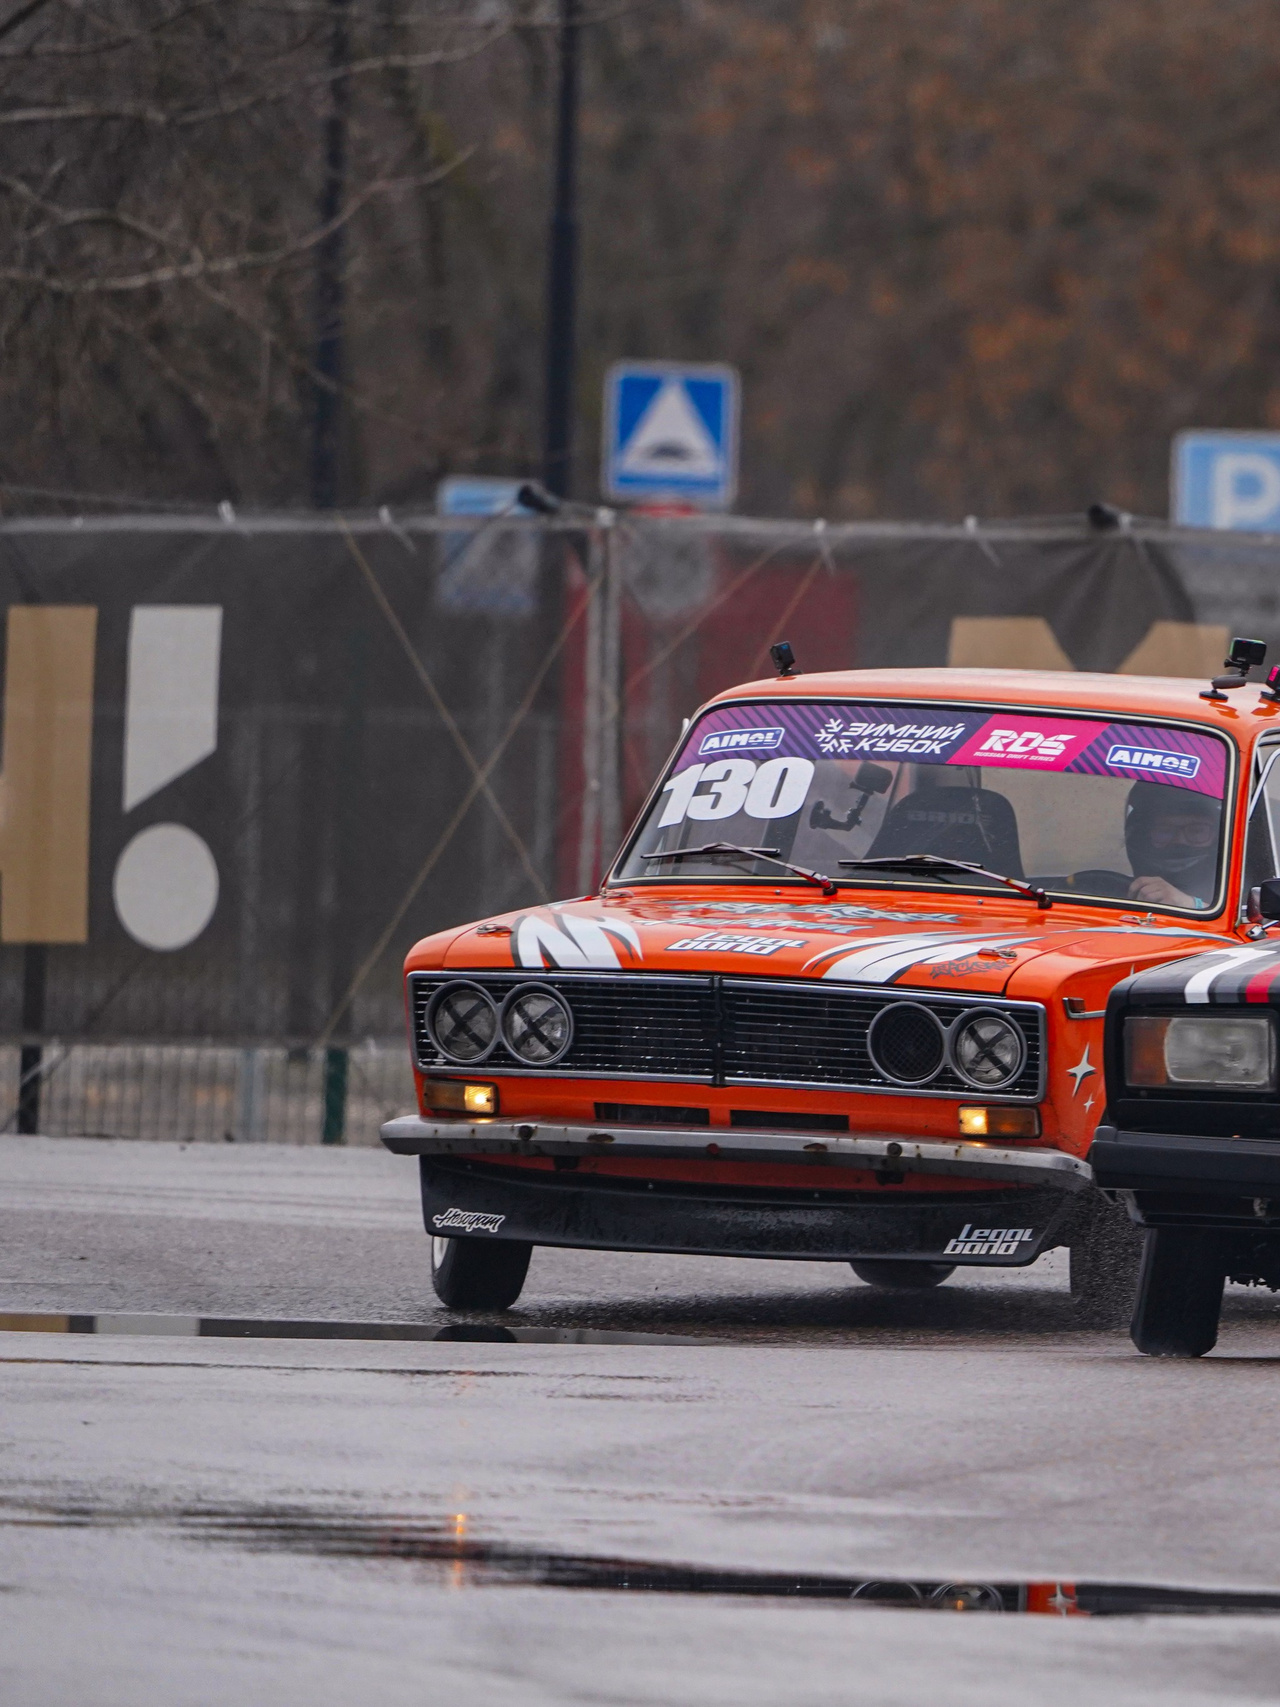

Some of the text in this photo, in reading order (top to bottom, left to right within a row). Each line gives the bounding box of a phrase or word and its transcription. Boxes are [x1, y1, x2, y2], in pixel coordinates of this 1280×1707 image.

[842, 723, 966, 740] ЗИМНИЙ
[703, 732, 777, 751] AIMOL
[854, 738, 952, 754] КУБОК
[979, 729, 1077, 756] RDS
[973, 751, 1007, 759] RUSSIAN
[1111, 749, 1194, 774] AIMOL
[657, 756, 815, 829] 130
[667, 938, 782, 956] band
[695, 931, 808, 949] Legal
[958, 1223, 1034, 1242] Legal
[942, 1238, 1019, 1255] band
